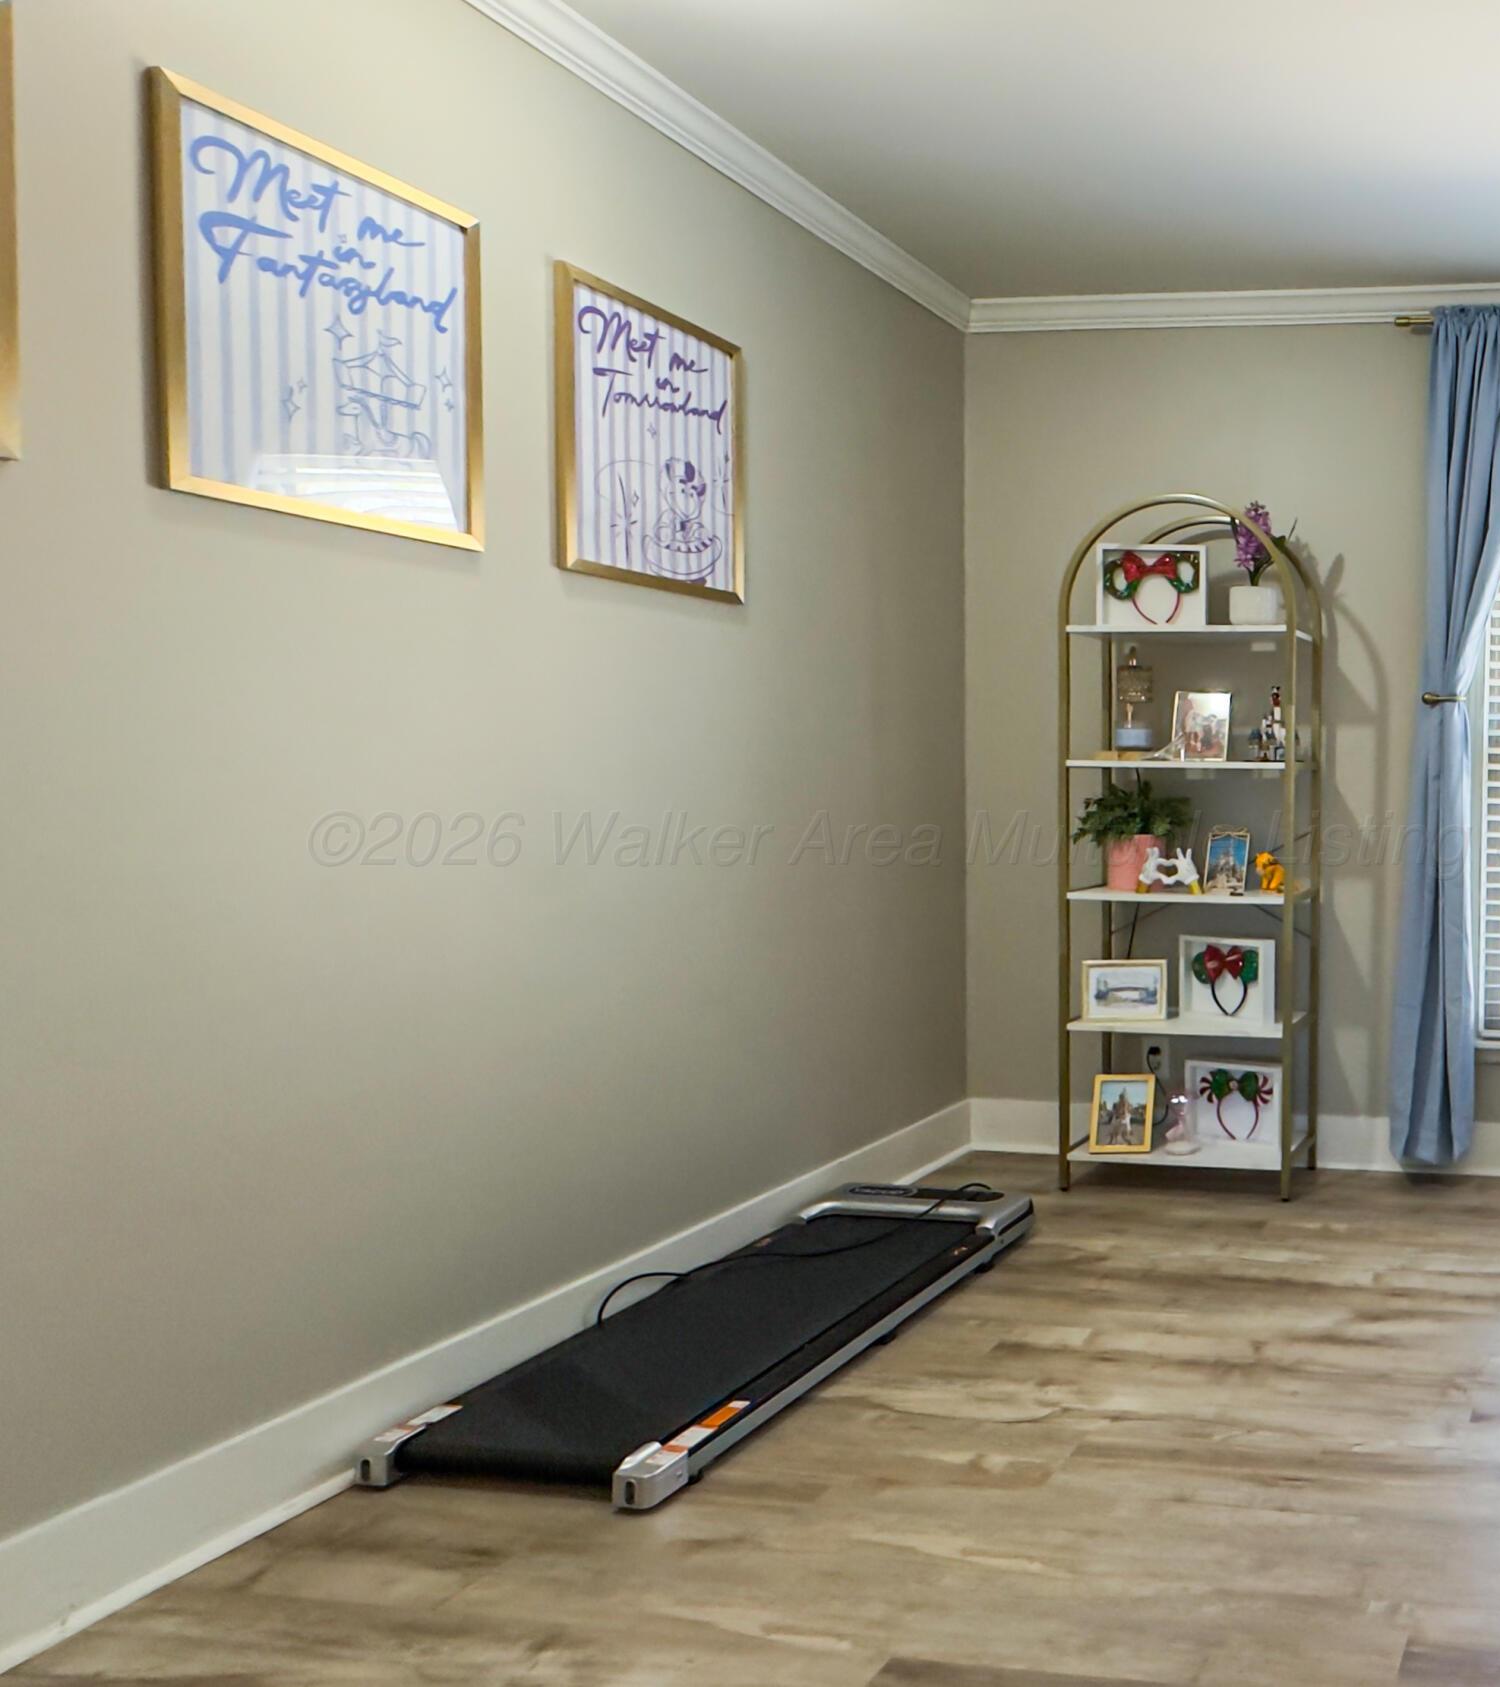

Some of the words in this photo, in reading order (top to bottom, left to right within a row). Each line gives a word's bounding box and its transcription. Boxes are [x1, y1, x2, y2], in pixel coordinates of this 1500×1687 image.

[189, 135, 352, 233] Meet
[357, 216, 426, 247] me
[198, 210, 457, 333] Fantasyland
[333, 244, 376, 269] in
[578, 306, 666, 369] Meet
[669, 352, 708, 373] me
[655, 377, 680, 393] in
